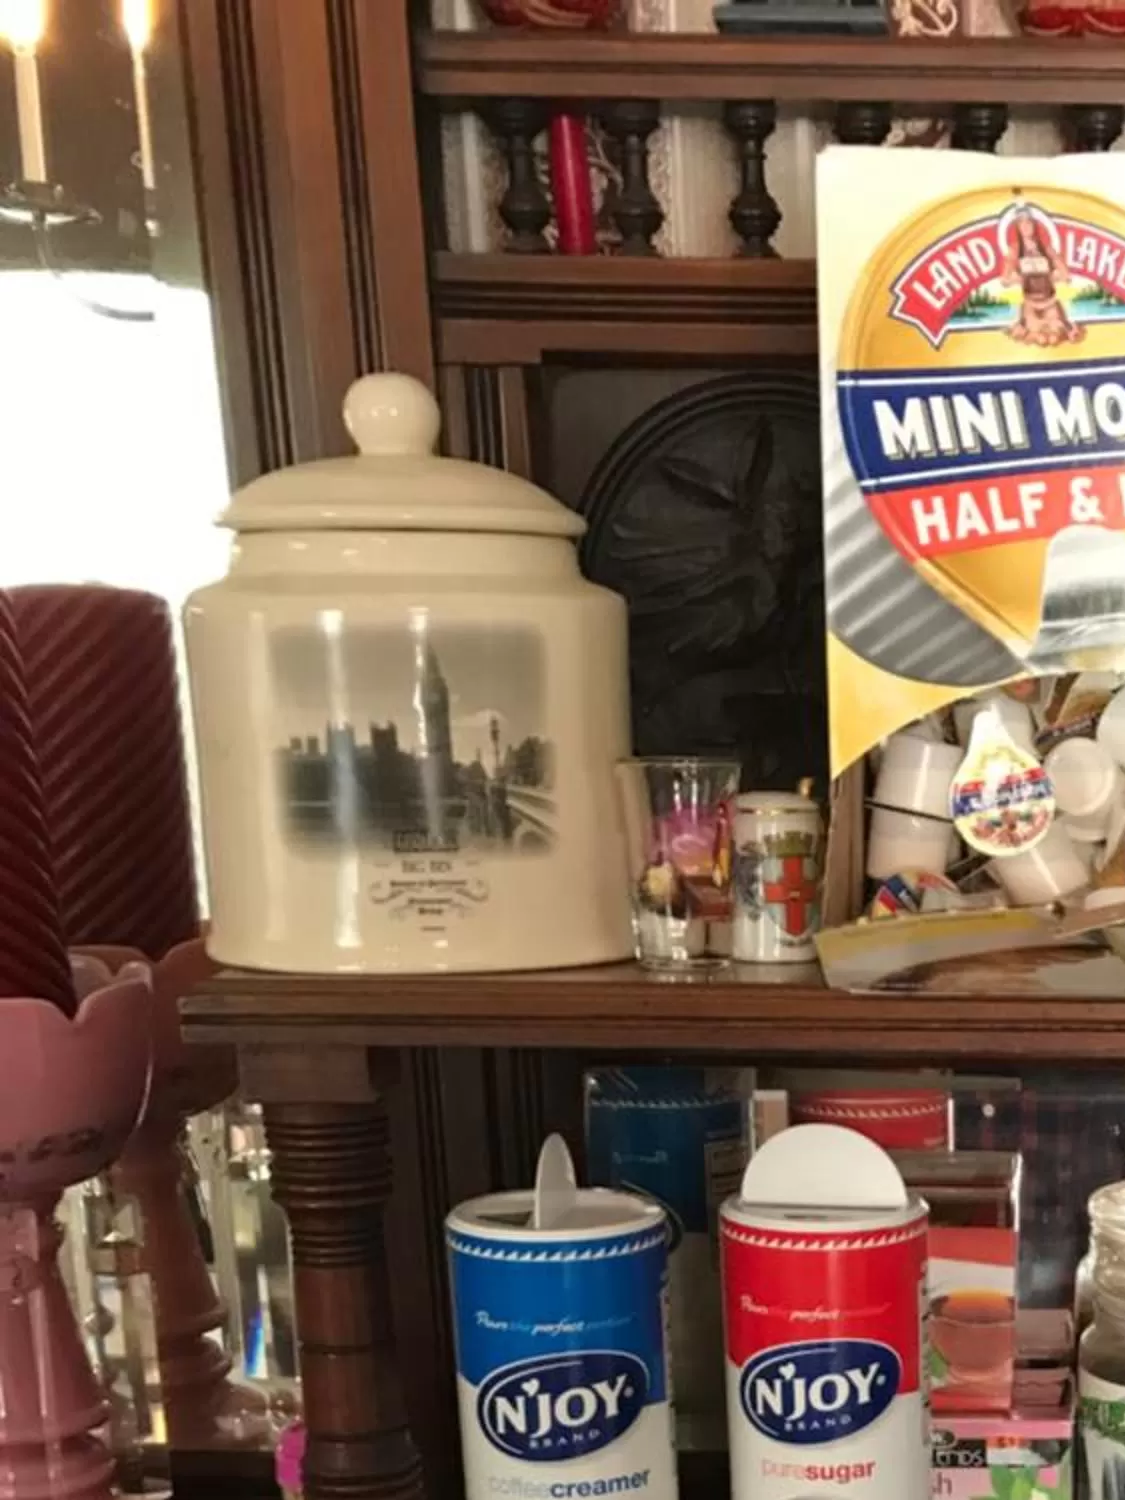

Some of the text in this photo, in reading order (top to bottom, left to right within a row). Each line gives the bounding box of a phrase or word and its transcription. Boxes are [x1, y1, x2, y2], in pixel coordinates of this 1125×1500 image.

[913, 236, 997, 311] LAND
[872, 389, 1030, 461] MINI
[910, 479, 1049, 546] HALF
[1068, 475, 1107, 523] &
[529, 1429, 601, 1449] BRAND
[784, 1413, 852, 1431] BRAND
